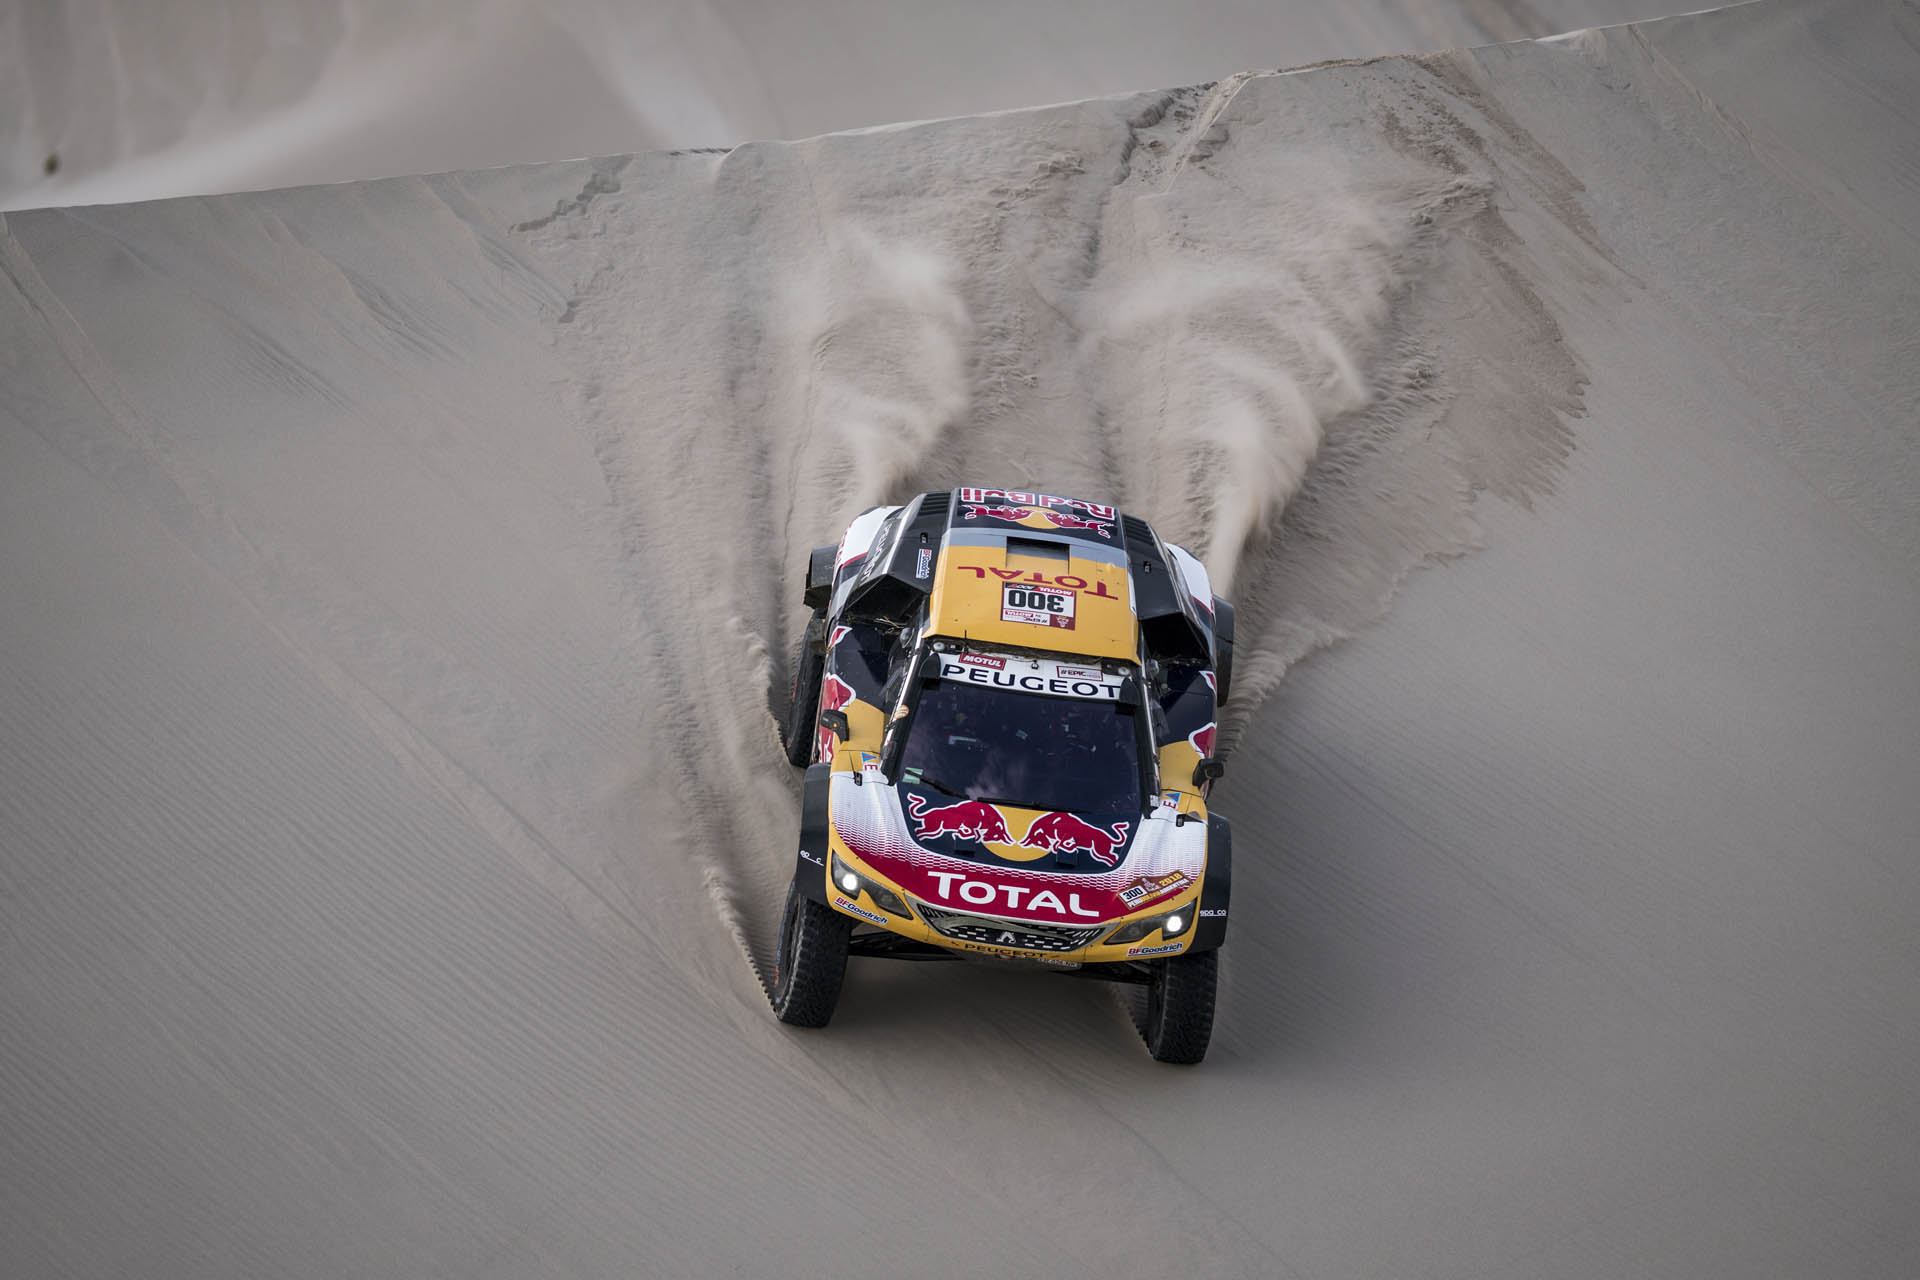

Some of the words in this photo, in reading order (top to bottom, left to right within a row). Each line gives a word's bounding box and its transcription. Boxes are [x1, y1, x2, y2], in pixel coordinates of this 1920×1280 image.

[960, 487, 1035, 506] Bull
[1039, 494, 1115, 521] Red
[957, 566, 1119, 601] TOTAL
[1039, 586, 1073, 595] MOTUL
[1008, 589, 1065, 613] 300
[962, 654, 1002, 668] MOTUL
[941, 663, 1122, 698] PEUGEOT
[927, 871, 1100, 917] TOTAL
[1122, 887, 1144, 901] 300
[1159, 872, 1183, 887] 2018
[835, 896, 888, 924] BFGoodrich
[964, 943, 1048, 958] PEUGEOT
[1128, 942, 1183, 954] BFGoodrich
